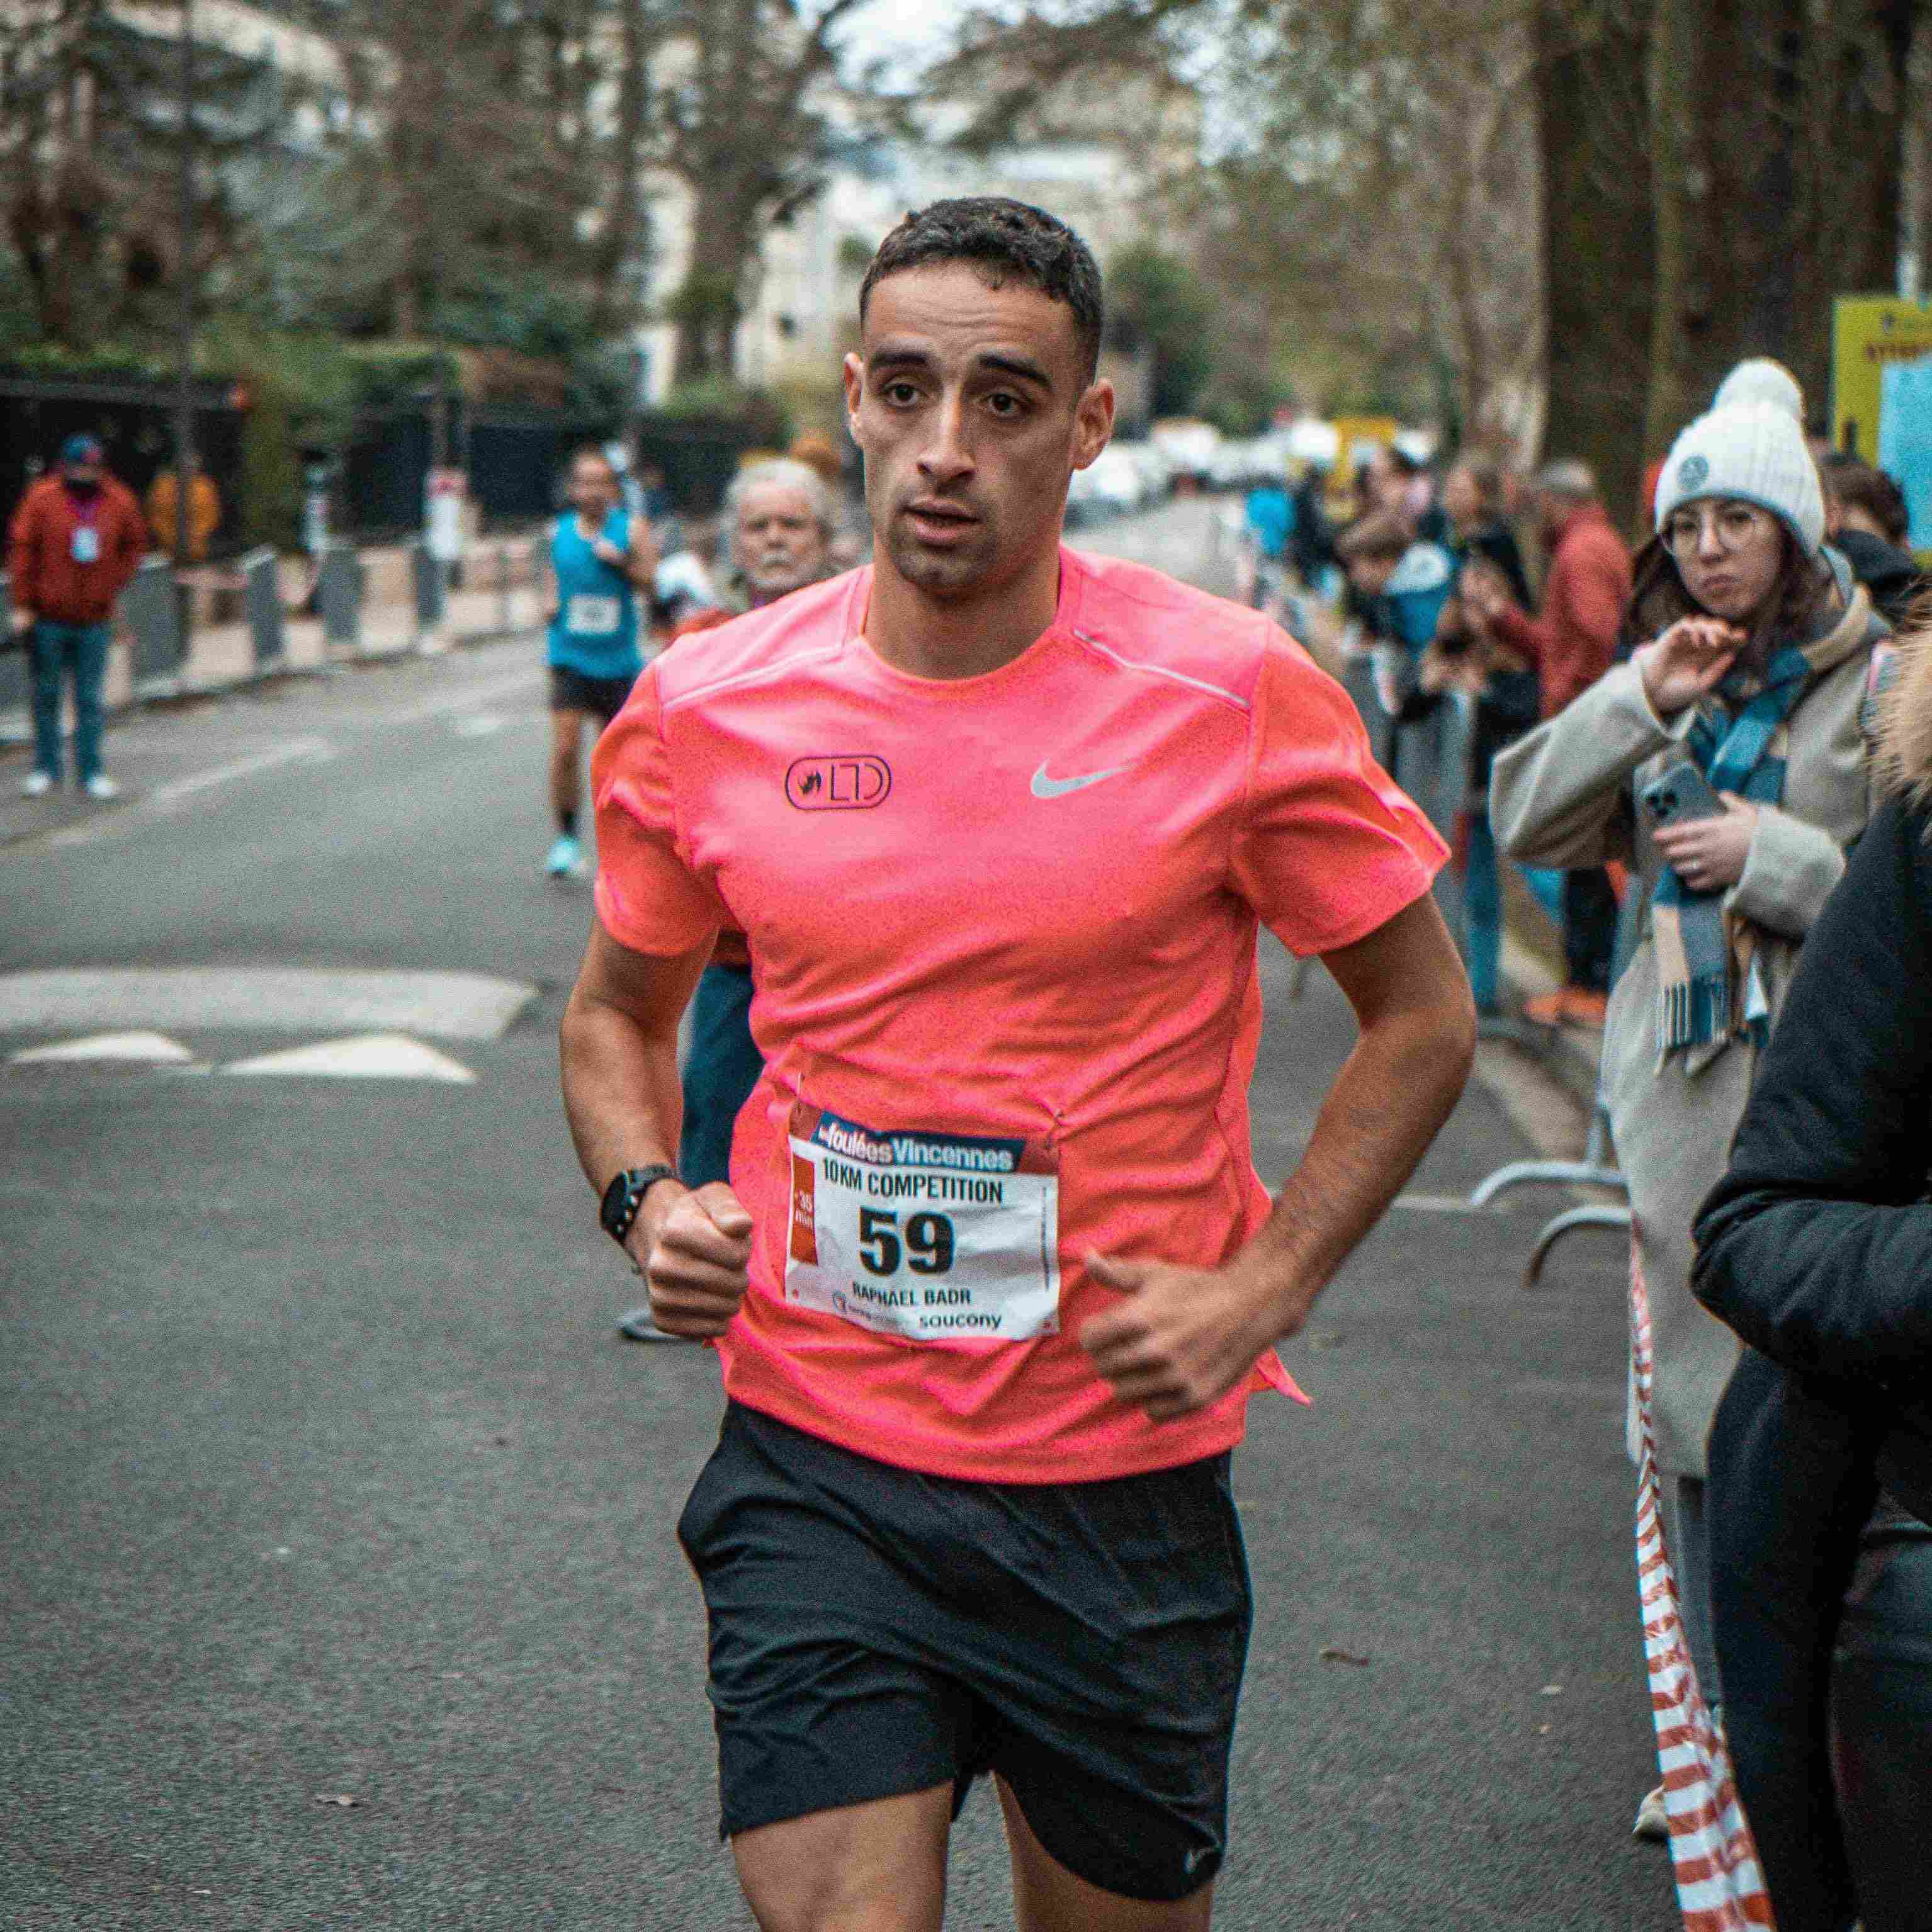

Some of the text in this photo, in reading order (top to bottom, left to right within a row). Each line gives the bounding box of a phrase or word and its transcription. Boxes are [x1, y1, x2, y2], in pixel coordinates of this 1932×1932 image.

[830, 764, 883, 800] LTD
[890, 1138, 1014, 1170] Vincennes
[823, 1157, 1002, 1203] 10KM COMPETITION
[859, 1206, 955, 1275] 59
[919, 1313, 1003, 1331] saucony
